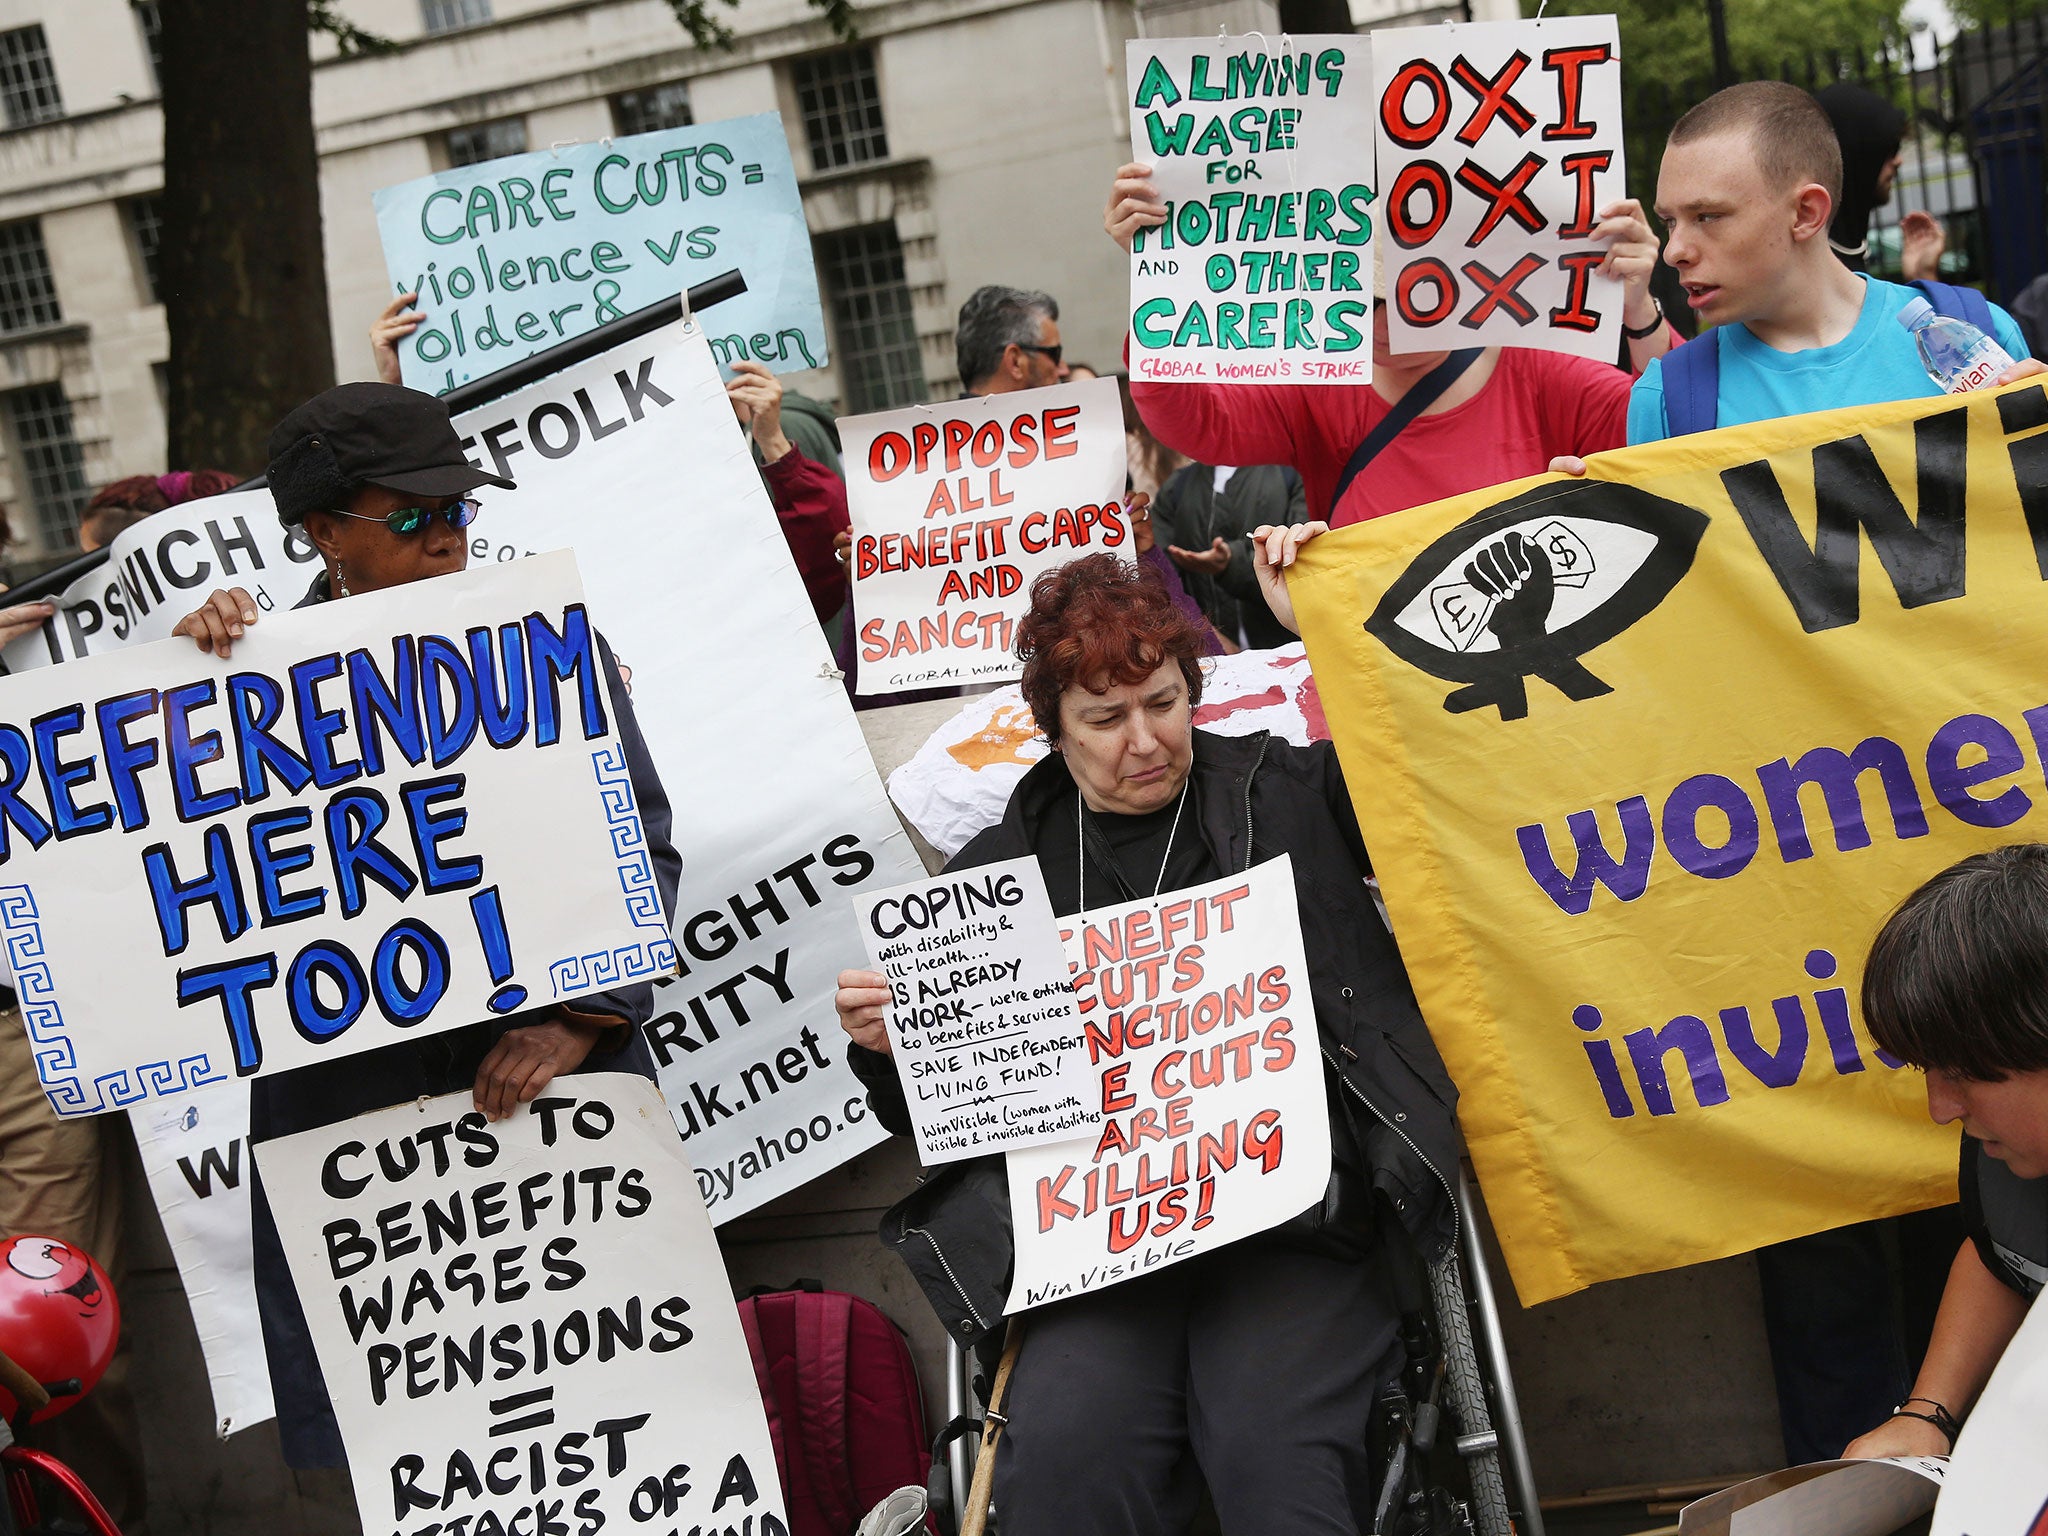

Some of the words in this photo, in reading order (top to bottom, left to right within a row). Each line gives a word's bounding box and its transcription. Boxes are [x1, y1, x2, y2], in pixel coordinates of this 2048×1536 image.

[1135, 55, 1182, 108] A
[1190, 48, 1345, 101] LIVING
[1380, 43, 1612, 150] OXI
[1145, 107, 1302, 156] WAGE
[421, 169, 576, 245] CARE
[594, 143, 734, 214] CUTS
[741, 164, 764, 185] =
[1207, 159, 1262, 184] FOR
[1386, 149, 1613, 249] OXI
[1133, 184, 1376, 254] MOTHERS
[397, 240, 632, 311] violence
[644, 226, 721, 266] vs
[1138, 259, 1179, 276] AND
[1205, 250, 1362, 293] OTHER
[1394, 251, 1605, 333] OXI
[416, 303, 583, 363] older
[594, 280, 628, 327] &
[707, 327, 817, 368] men
[1133, 297, 1367, 353] CARERS
[1139, 358, 1206, 377] GLOBAL
[1216, 358, 1292, 378] WOMEN'S
[1301, 359, 1364, 377] STRIKE
[868, 405, 1080, 483] OPPOSE
[42, 516, 266, 665] IPSWICH
[461, 356, 675, 497] FOLK
[923, 468, 1014, 518] ALL
[1719, 384, 2048, 634] Wi
[856, 516, 1013, 581] BENEFIT
[1019, 501, 1126, 554] CAPS
[936, 564, 1023, 606] AND
[860, 610, 1014, 663] SANCTI
[889, 667, 967, 686] GLOBAL
[971, 662, 1023, 676] WOME
[0, 603, 608, 864] REFERENDUM
[141, 773, 484, 957] HERE
[655, 833, 875, 988] IGHTS
[870, 874, 1024, 939] COPING
[878, 943, 913, 962] with
[918, 920, 998, 953] disability
[999, 914, 1014, 930] &
[176, 883, 530, 1077] TOO!
[642, 947, 795, 1068] RITY
[889, 981, 911, 1009] IS
[918, 958, 1023, 999] ALREADY
[990, 990, 1030, 1008] we're
[1034, 981, 1075, 999] entitled
[1073, 944, 1206, 1012] CUTS
[1084, 965, 1292, 1066] NCTIONS
[900, 1035, 922, 1049] to
[928, 1021, 995, 1046] benefits
[997, 1015, 1011, 1030] &
[1012, 1005, 1071, 1026] services
[910, 1056, 963, 1079] SAVE
[973, 1035, 1087, 1067] INDEPENDENT
[1152, 1018, 1296, 1100] CUTS
[1571, 949, 1906, 1119] invi
[670, 1025, 831, 1142] uk.net
[917, 1075, 989, 1101] LIVING
[1000, 1055, 1062, 1086] FUND!
[1054, 1096, 1082, 1112] with
[321, 1111, 499, 1199] CUTS
[529, 1097, 616, 1148] TO
[927, 1136, 968, 1152] visible
[972, 1131, 983, 1145] &
[987, 1124, 1035, 1142] invisible
[1092, 1095, 1193, 1163] ARE
[1037, 1109, 1281, 1234] KILLING
[322, 1166, 652, 1280] BENEFITS
[1108, 1176, 1215, 1254] US!
[338, 1237, 587, 1345] WAGES
[367, 1296, 694, 1406] PENSIONS
[488, 1386, 555, 1438] =
[391, 1413, 652, 1521] RACIST
[629, 1464, 691, 1522] OF
[712, 1453, 758, 1513] A
